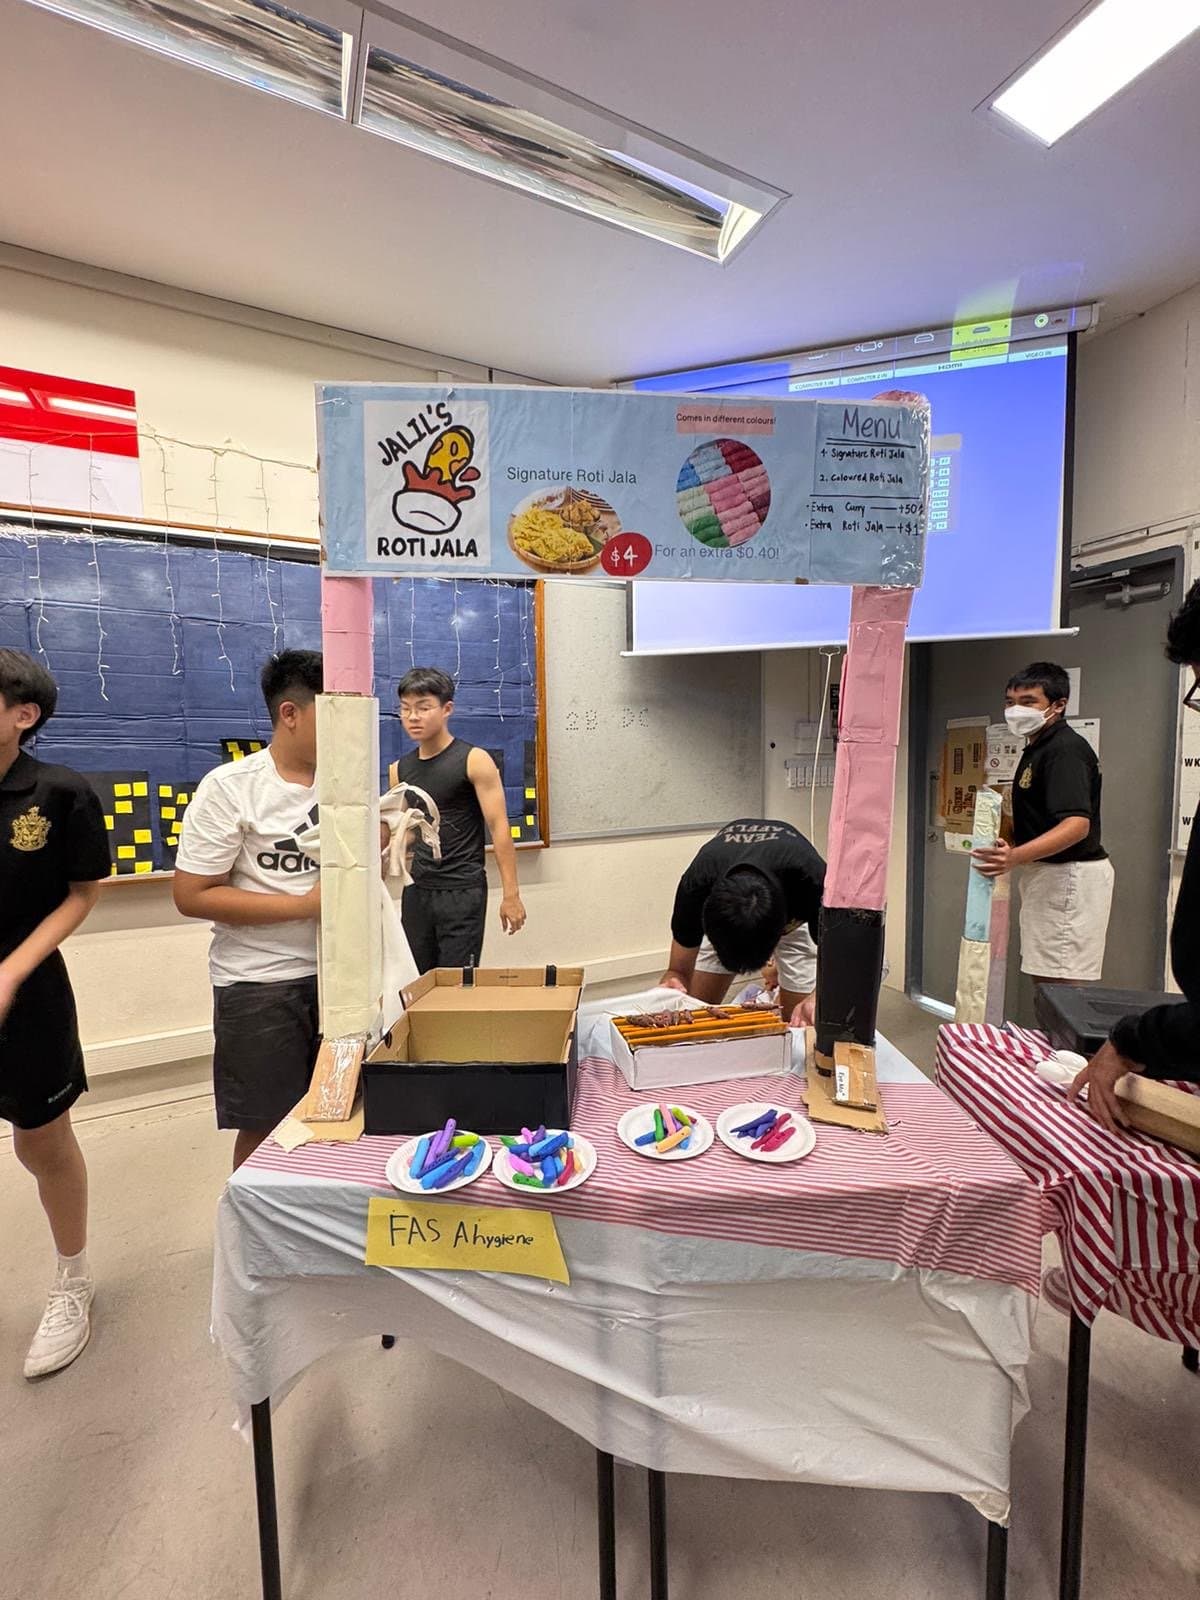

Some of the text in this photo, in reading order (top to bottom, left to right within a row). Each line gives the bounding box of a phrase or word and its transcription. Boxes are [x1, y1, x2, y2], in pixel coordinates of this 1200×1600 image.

[676, 413, 777, 425] Comes in different colours!
[842, 407, 900, 439] Menu
[377, 402, 453, 466] JALIL'S
[831, 448, 868, 461] Signature
[870, 448, 887, 459] Roti
[888, 449, 905, 459] Jala
[507, 467, 637, 484] Signature Roti Jala
[831, 472, 867, 482] Coloured
[869, 472, 885, 483] Roti
[887, 474, 903, 484] Jala
[811, 502, 834, 514] Extra
[845, 501, 865, 517] Curry
[810, 518, 832, 531] Extra
[842, 520, 860, 531] Roti
[865, 520, 884, 532] Jala
[377, 537, 478, 557] ROTI JALA
[655, 545, 780, 560] For an extra $0.40!
[610, 545, 638, 567] $4
[724, 832, 779, 843] TEAM
[389, 1213, 441, 1247] FAS
